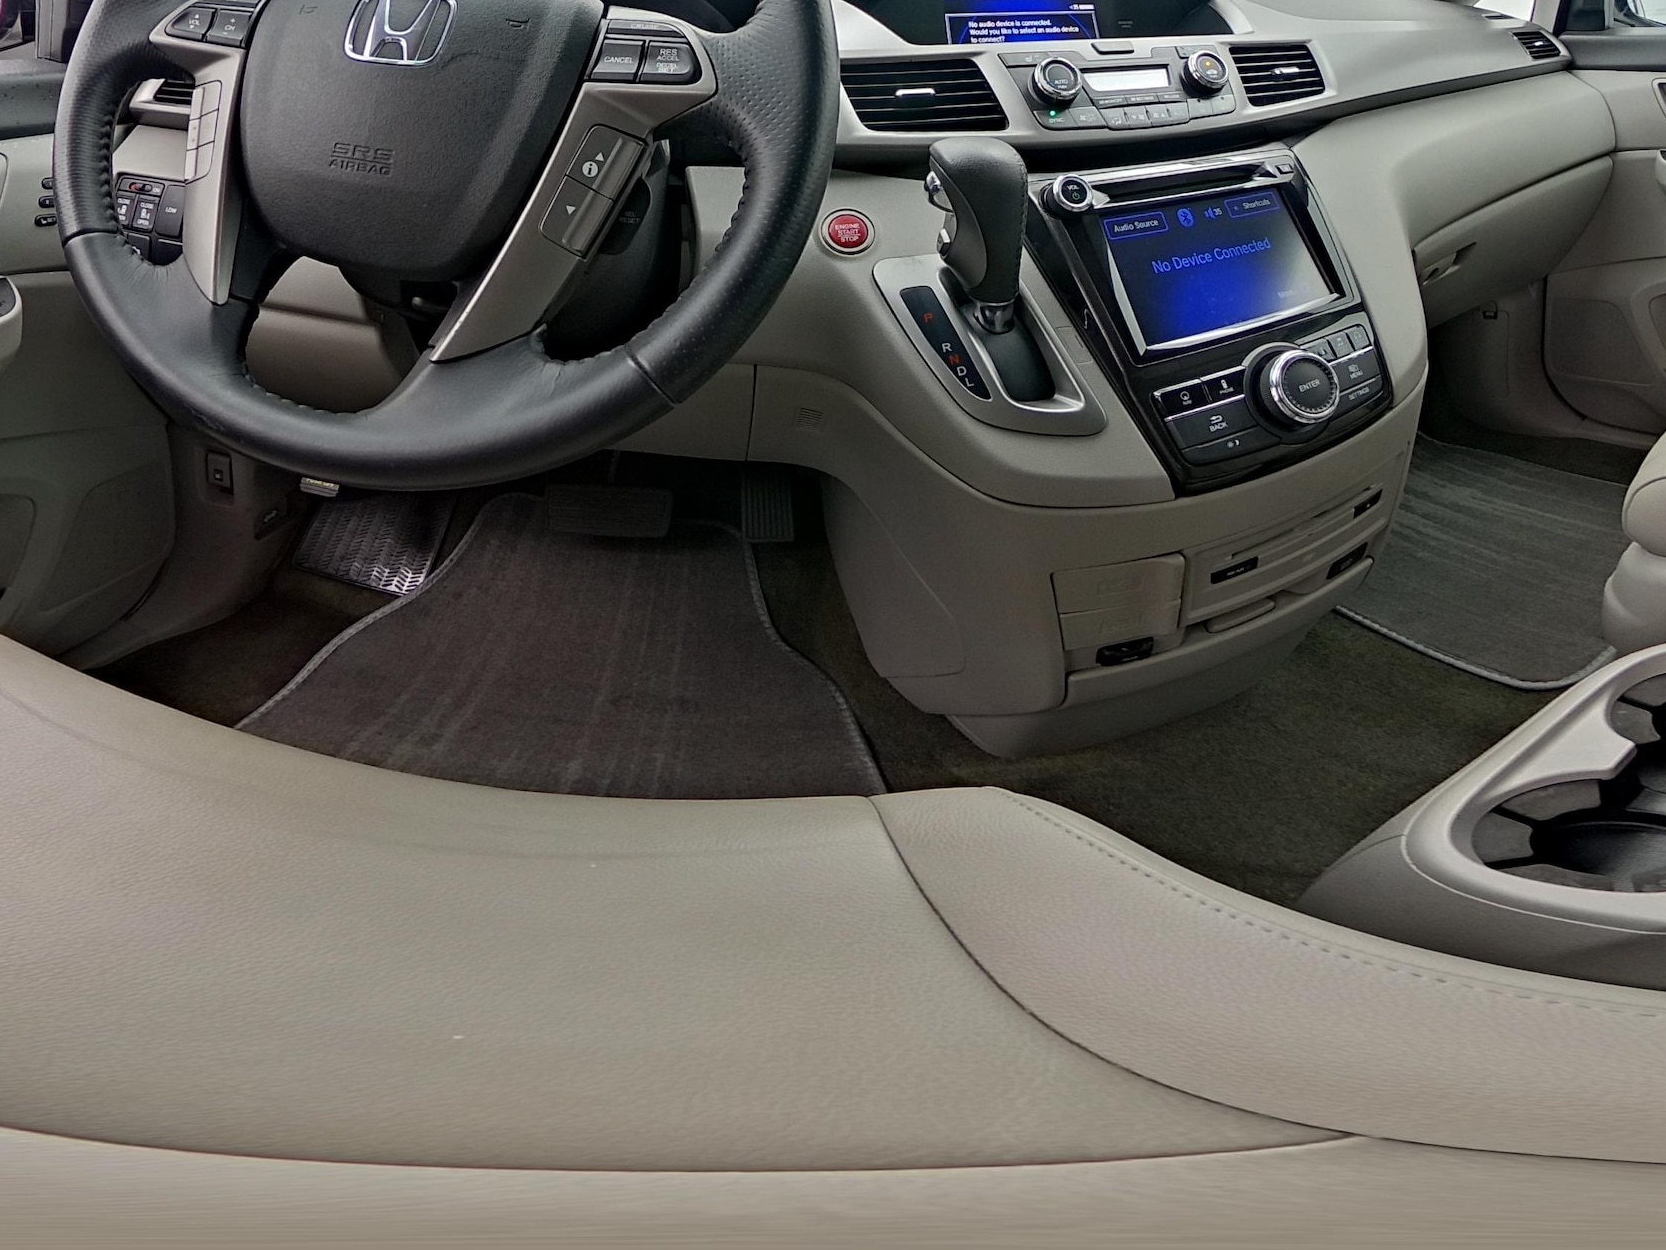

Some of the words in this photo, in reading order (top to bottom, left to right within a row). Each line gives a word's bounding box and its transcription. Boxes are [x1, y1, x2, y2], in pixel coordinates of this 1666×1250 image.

[188, 18, 200, 26] VOL
[978, 20, 996, 28] audio
[1014, 19, 1021, 27] is
[1021, 19, 1052, 27] connected.
[968, 28, 989, 36] Would
[1061, 25, 1080, 33] device
[978, 35, 1006, 43] connect?
[604, 56, 634, 64] CANCEL
[333, 142, 394, 161] SRS
[329, 159, 392, 176] AIRBAG
[1242, 197, 1271, 210] Shortcuts
[165, 206, 179, 214] LOW
[1213, 207, 1223, 217] 35
[834, 223, 861, 231] ENGINE
[1113, 221, 1134, 234] Audio
[1134, 218, 1159, 230] Source
[836, 228, 861, 236] START
[840, 235, 860, 243] STOP
[1151, 258, 1171, 275] No
[1172, 250, 1213, 270] Device
[1213, 237, 1272, 262] Connected
[923, 312, 934, 323] P
[941, 342, 953, 353] R
[948, 354, 960, 365] N
[956, 366, 967, 377] D
[1349, 370, 1364, 380] MENU
[964, 377, 975, 388] L
[1298, 379, 1321, 393] ENTER
[1348, 386, 1370, 401] SETTINGS
[1208, 421, 1228, 433] BACK
